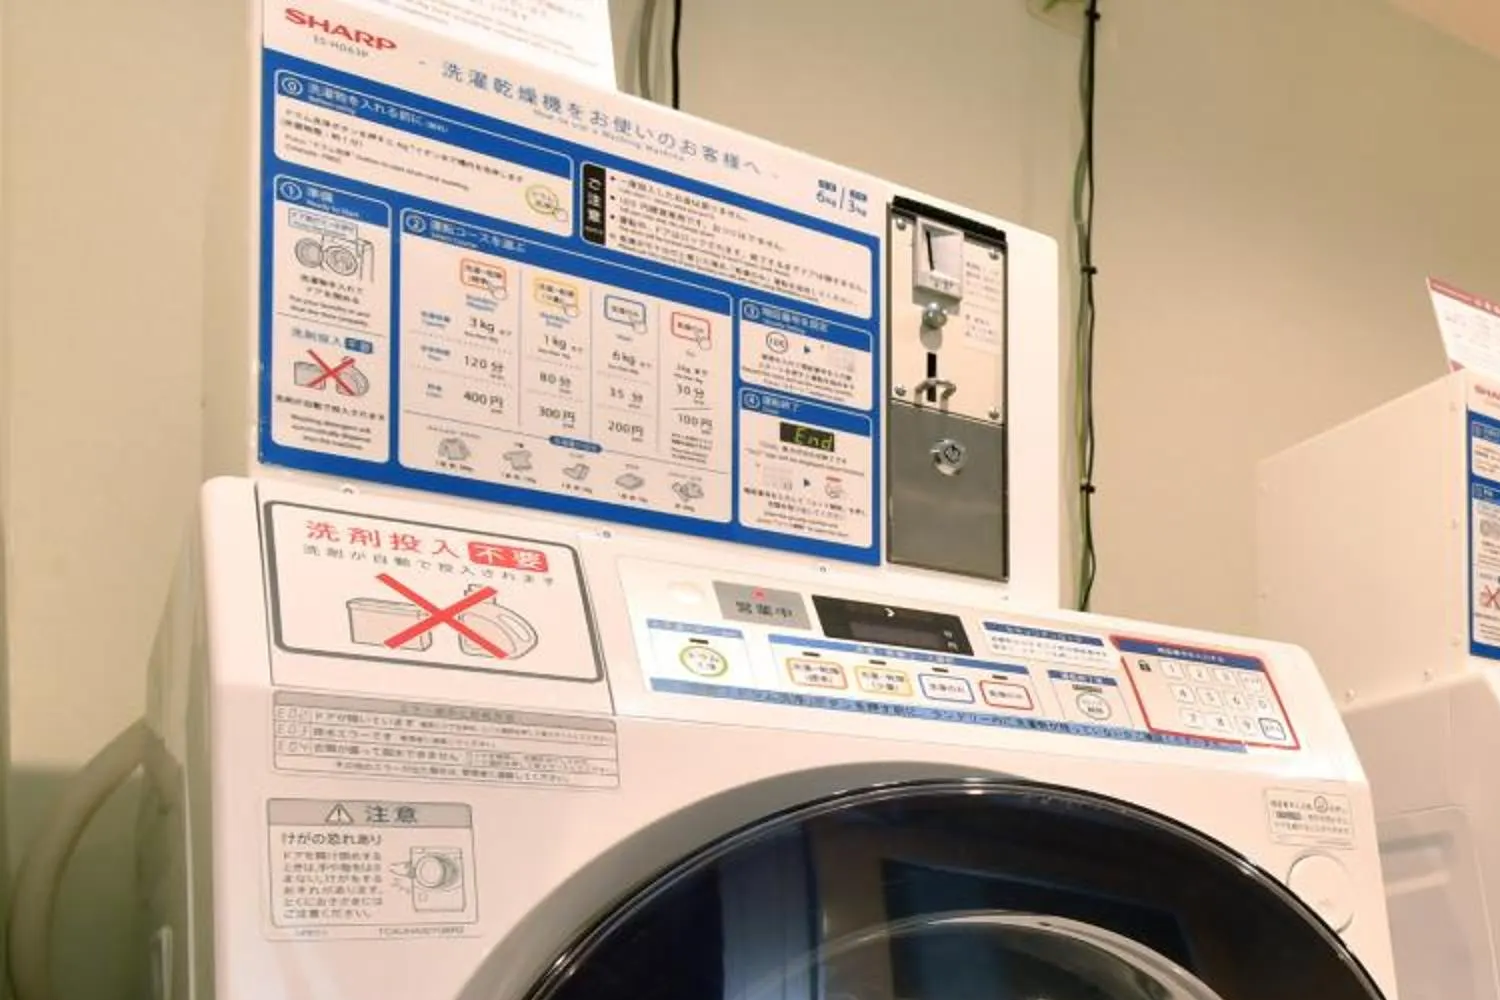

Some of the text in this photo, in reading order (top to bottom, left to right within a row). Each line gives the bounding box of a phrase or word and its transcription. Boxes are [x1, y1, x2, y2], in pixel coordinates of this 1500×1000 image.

[285, 7, 397, 50] SHARP
[303, 543, 554, 587] 洗剤が自動で投入されます
[305, 520, 543, 571] 洗剤投入 不要
[366, 804, 418, 825] 注意
[281, 831, 383, 846] けがの恐れあり
